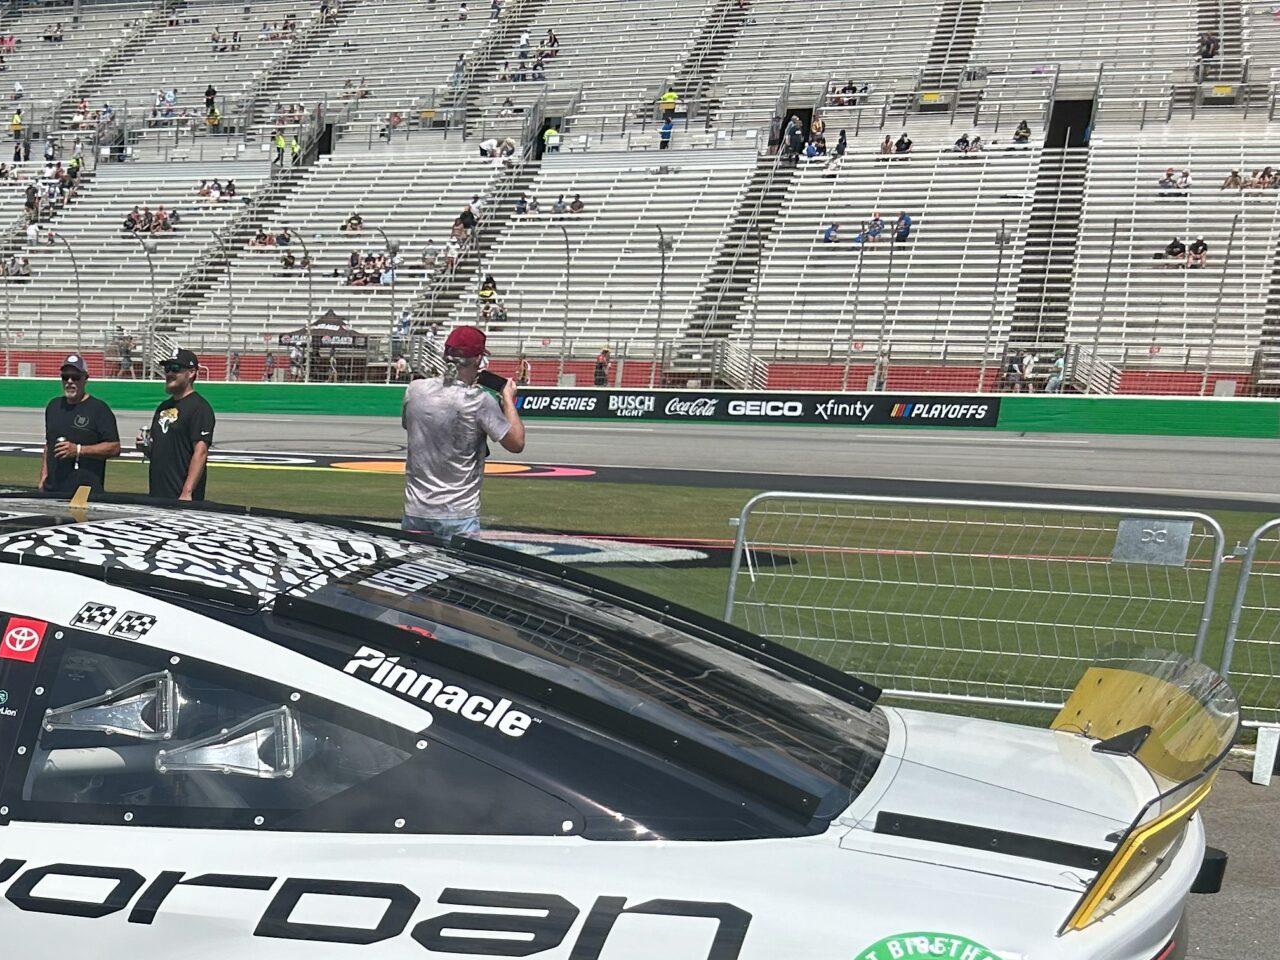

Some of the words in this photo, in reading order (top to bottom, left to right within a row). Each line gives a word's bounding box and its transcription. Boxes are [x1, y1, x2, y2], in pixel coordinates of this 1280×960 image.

[523, 396, 549, 410] CUP
[550, 397, 597, 411] SERIES
[608, 395, 656, 412] BUSCH
[727, 400, 802, 417] GEICO
[815, 399, 874, 421] xfinity
[911, 403, 989, 419] PLAYOFFS
[616, 409, 644, 417] LIGHT
[343, 645, 532, 737] Pinnacle
